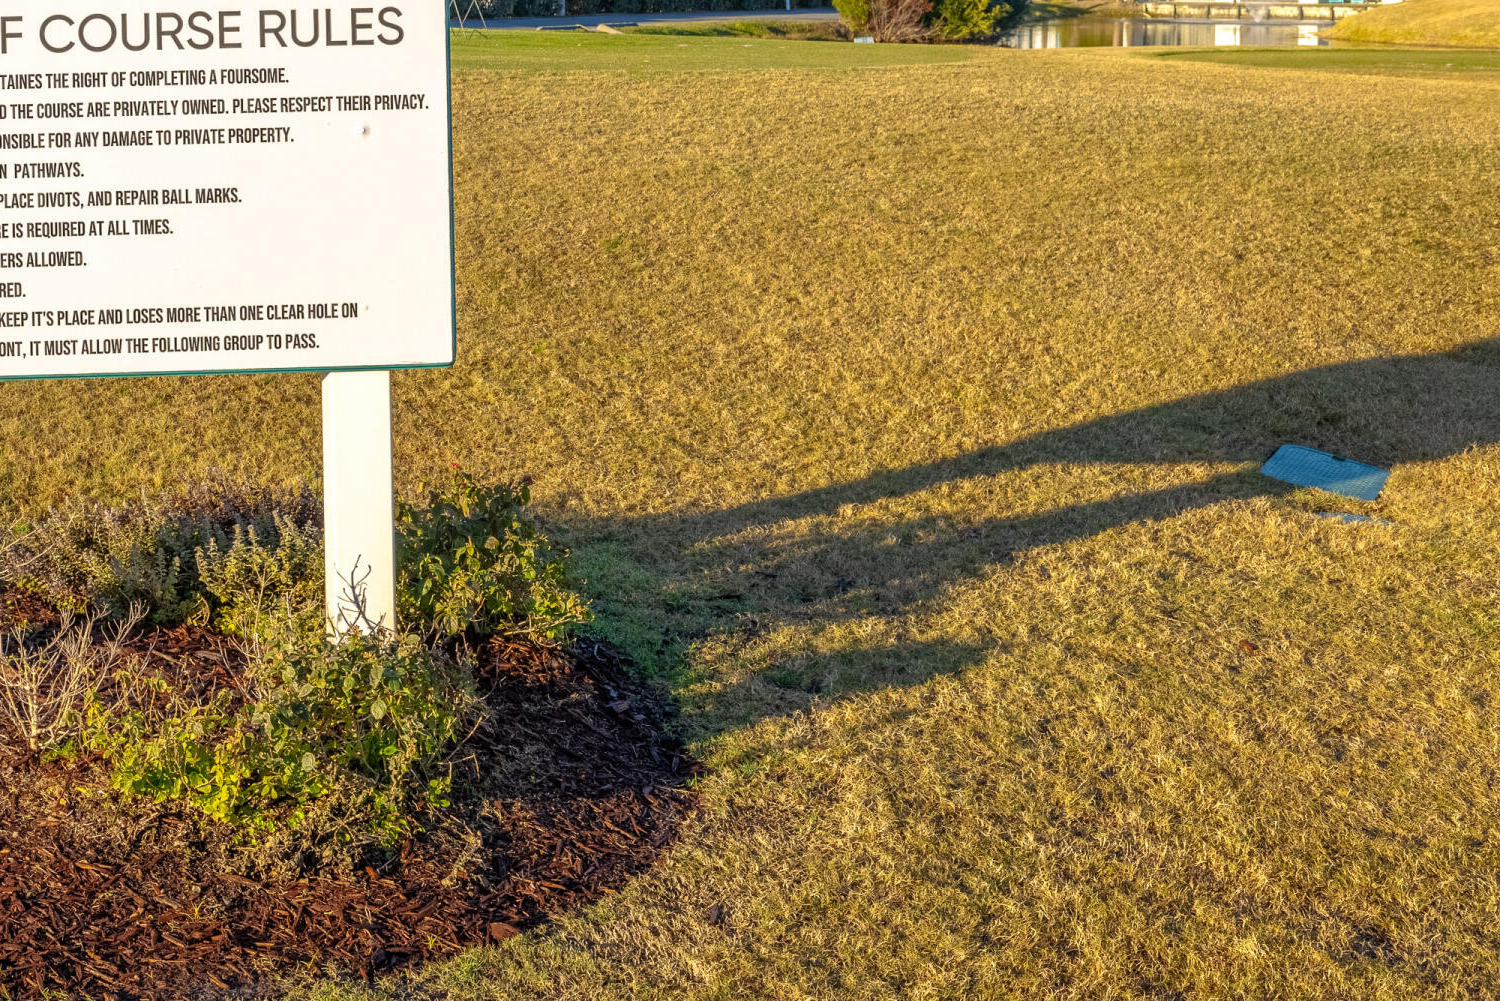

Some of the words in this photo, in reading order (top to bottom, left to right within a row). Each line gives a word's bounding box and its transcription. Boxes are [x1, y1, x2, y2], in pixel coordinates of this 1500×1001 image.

[40, 11, 241, 53] COURSE
[259, 7, 404, 47] RULES
[46, 73, 69, 88] THE
[73, 72, 108, 88] RIGHT
[112, 72, 126, 87] OF
[130, 70, 205, 86] COMPLETING
[209, 70, 217, 84] A
[221, 68, 288, 84] FOURSOME.
[10, 104, 33, 119] THE
[37, 103, 83, 118] COURSE
[87, 102, 110, 117] ARE
[114, 100, 178, 116] PRIVATELY
[182, 99, 228, 115] OWNED.
[233, 98, 277, 113] PLEASE
[281, 97, 333, 112] RESPECT
[336, 96, 371, 111] THEIR
[375, 94, 428, 110] PRIVACY.
[49, 133, 71, 148] FOR
[75, 132, 99, 147] ANY
[103, 131, 153, 146] DAMAGE
[156, 130, 171, 145] TO
[175, 129, 225, 145] PRIVATE
[229, 127, 294, 143] PROPERTY.
[15, 162, 84, 178] PATHWAYS.
[38, 192, 83, 208] DIVOTS,
[88, 191, 112, 206] AND
[116, 190, 158, 205] REPAIR
[162, 189, 192, 204] BALL
[196, 188, 241, 203] MARKS.
[12, 223, 23, 238] IS
[27, 222, 85, 238] REQUIRED
[89, 221, 104, 236] AT
[108, 220, 129, 235] ALL
[132, 219, 173, 235] TIMES.
[27, 251, 86, 267] ALLOWED.
[32, 311, 53, 326] IT'S
[58, 310, 95, 325] PLACE
[98, 309, 122, 324] AND
[126, 308, 163, 324] LOSES
[167, 307, 201, 323] MORE
[204, 306, 236, 322] THAN
[240, 306, 263, 320] ONE
[267, 304, 304, 320] CLEAR
[308, 304, 338, 319] HOLE
[342, 303, 357, 318] ON
[30, 341, 41, 356] IT
[45, 340, 78, 355] MUST
[82, 339, 122, 354] ALLOW
[126, 338, 149, 353] THE
[152, 336, 220, 352] FOLLOWING
[224, 335, 263, 350] GROUP
[266, 334, 281, 349] TO
[286, 333, 319, 349] PASS.
